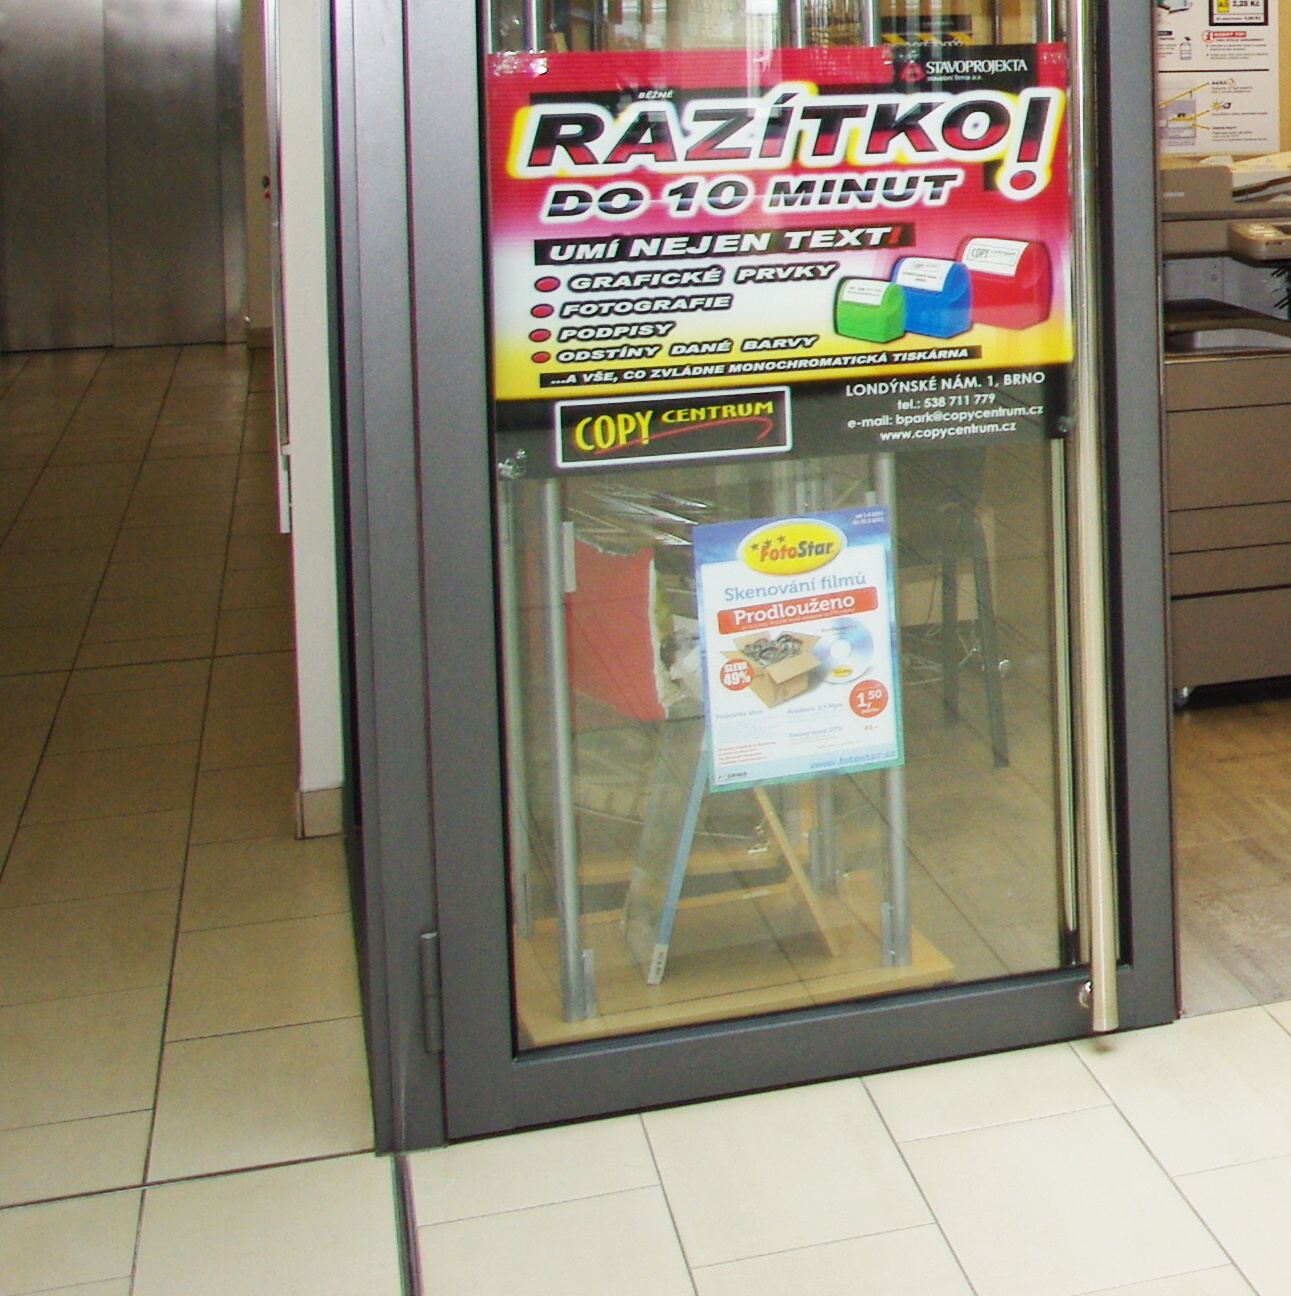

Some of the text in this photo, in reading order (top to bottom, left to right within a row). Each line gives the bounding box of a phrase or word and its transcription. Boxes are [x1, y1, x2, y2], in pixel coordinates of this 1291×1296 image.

[925, 58, 1028, 75] STAVOPROJEKTA
[524, 88, 1056, 194] RAZÍTKO!
[546, 173, 959, 219] DO 10 MINUT
[550, 238, 620, 262] UMÍ
[629, 231, 772, 258] NEJEN
[569, 263, 836, 291] GRAFICKÉ PRVKY
[560, 294, 732, 317] FOTOGRAFIE
[558, 322, 674, 341] PODPISY
[556, 335, 818, 363] ODSTÍNY DANÉ BARVY
[623, 368, 647, 380] CO
[650, 363, 726, 378] ZVLÁDNE
[728, 352, 888, 375] MONOCHROMATICKÁ
[892, 348, 970, 363] TISKÁRNA
[846, 377, 937, 397] LONDÝNSKÉ
[941, 374, 982, 391] NÁM.
[1003, 371, 1046, 386] BRNO
[924, 397, 946, 408] 538
[949, 395, 970, 406] 711
[974, 393, 996, 404] 779
[574, 399, 775, 453] COPY CENTRUM
[847, 405, 1044, 429] e-mail: bpark@copycentrum.cz
[880, 420, 1017, 441] www.copycentrum.cz
[760, 540, 834, 562] FotoStar
[734, 595, 855, 626] Prodlouženo
